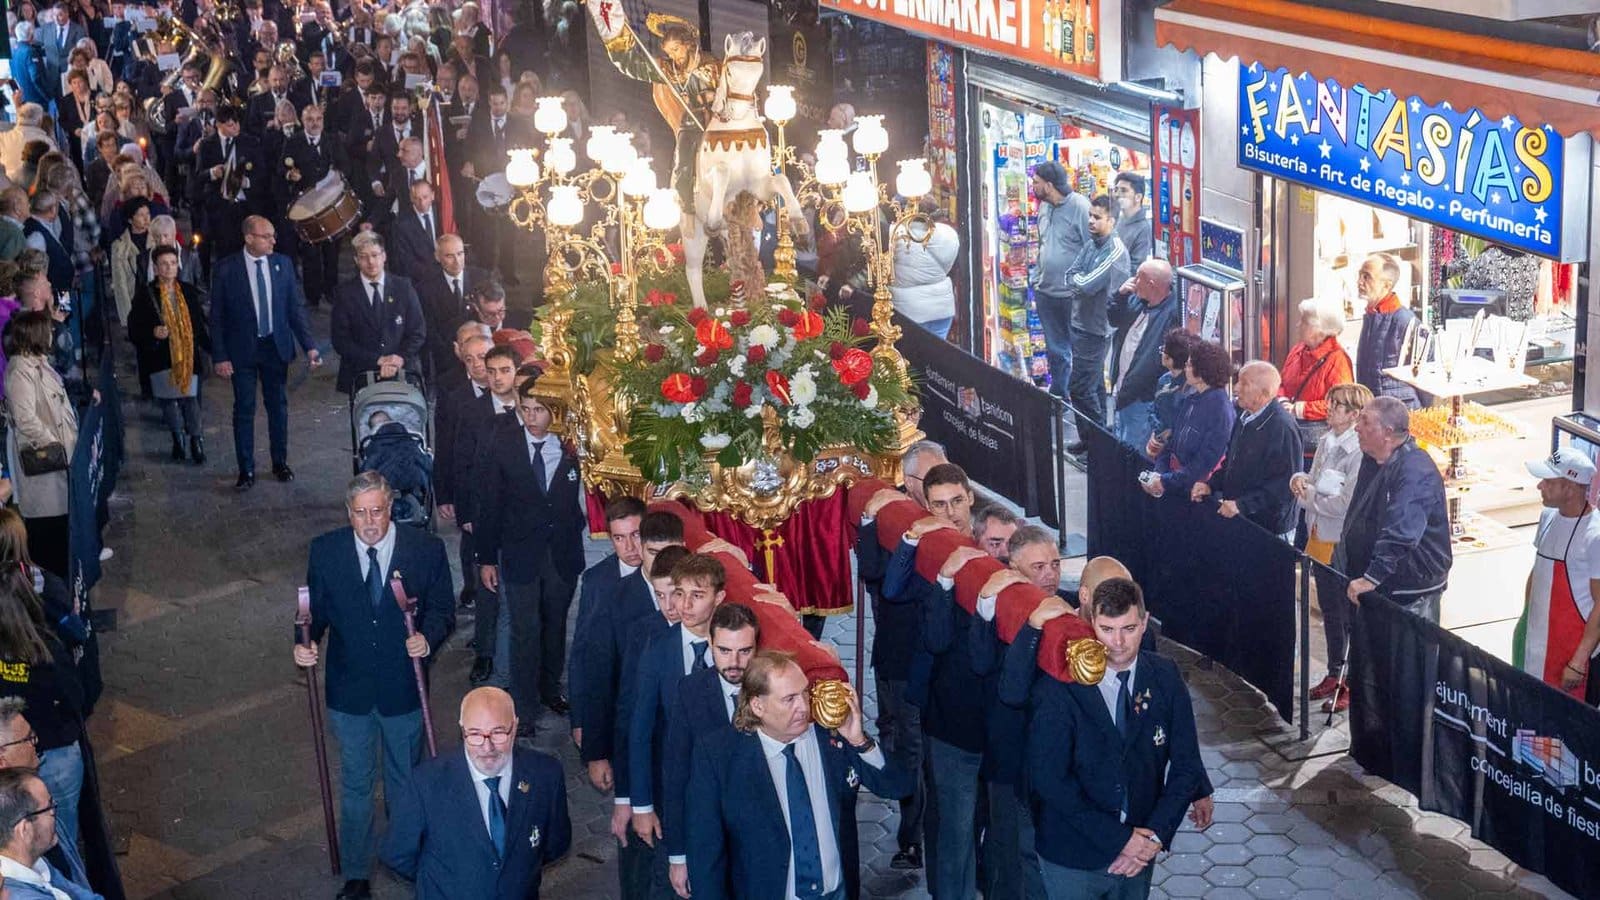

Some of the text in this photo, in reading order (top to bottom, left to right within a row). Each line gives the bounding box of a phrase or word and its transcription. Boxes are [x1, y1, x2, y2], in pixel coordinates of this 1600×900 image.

[853, 0, 1030, 48] MARKET
[1246, 70, 1553, 205] FANTASÍAS
[1245, 143, 1307, 174] Bisutería
[1320, 164, 1347, 185] Art.
[1351, 173, 1371, 193] de
[1375, 180, 1434, 211] Regalo
[1449, 200, 1552, 244] Perfumería
[1436, 681, 1508, 738] ajunment
[1545, 796, 1563, 818] de
